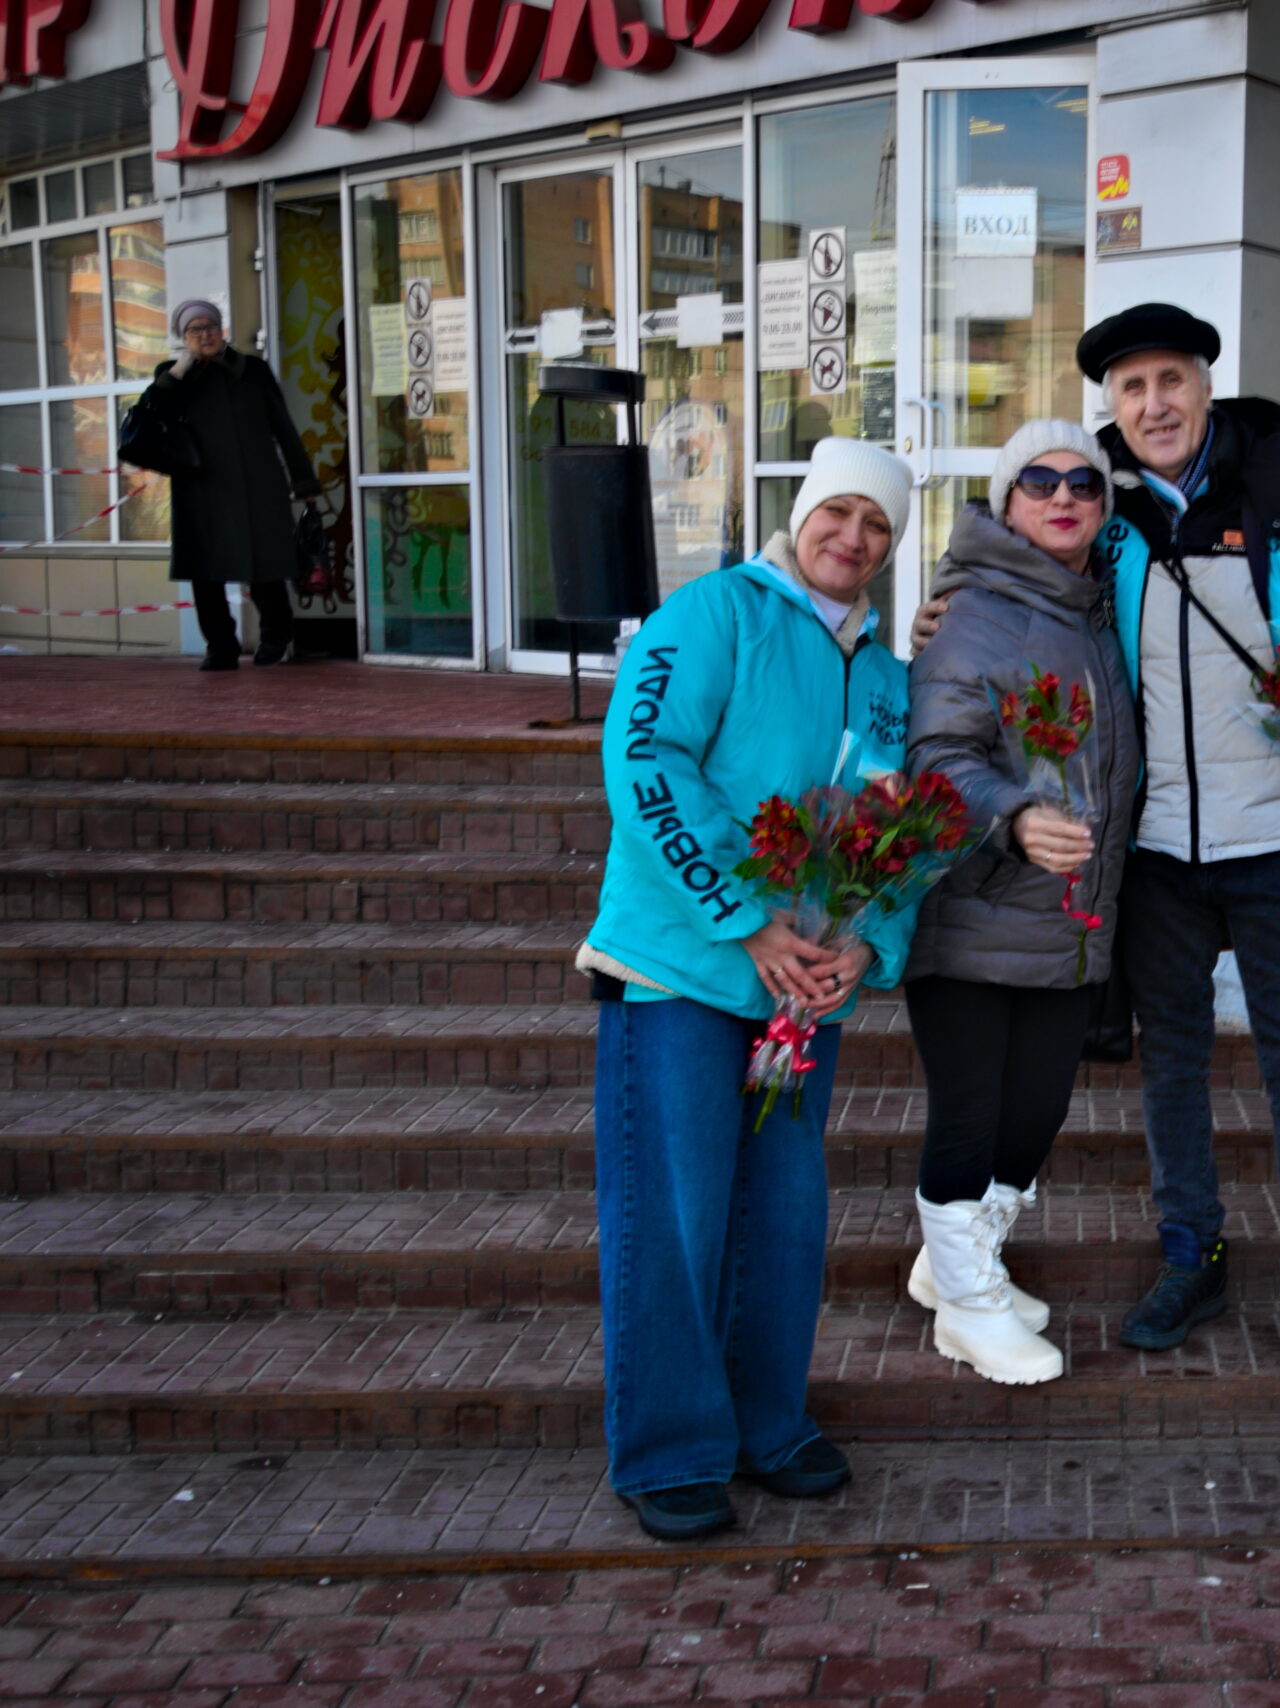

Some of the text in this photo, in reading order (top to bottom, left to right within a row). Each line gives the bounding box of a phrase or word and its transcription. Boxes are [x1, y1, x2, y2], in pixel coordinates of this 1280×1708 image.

[964, 214, 1030, 239] ВХОД
[625, 646, 743, 924] НОВЫЕ ЛЮДИ
